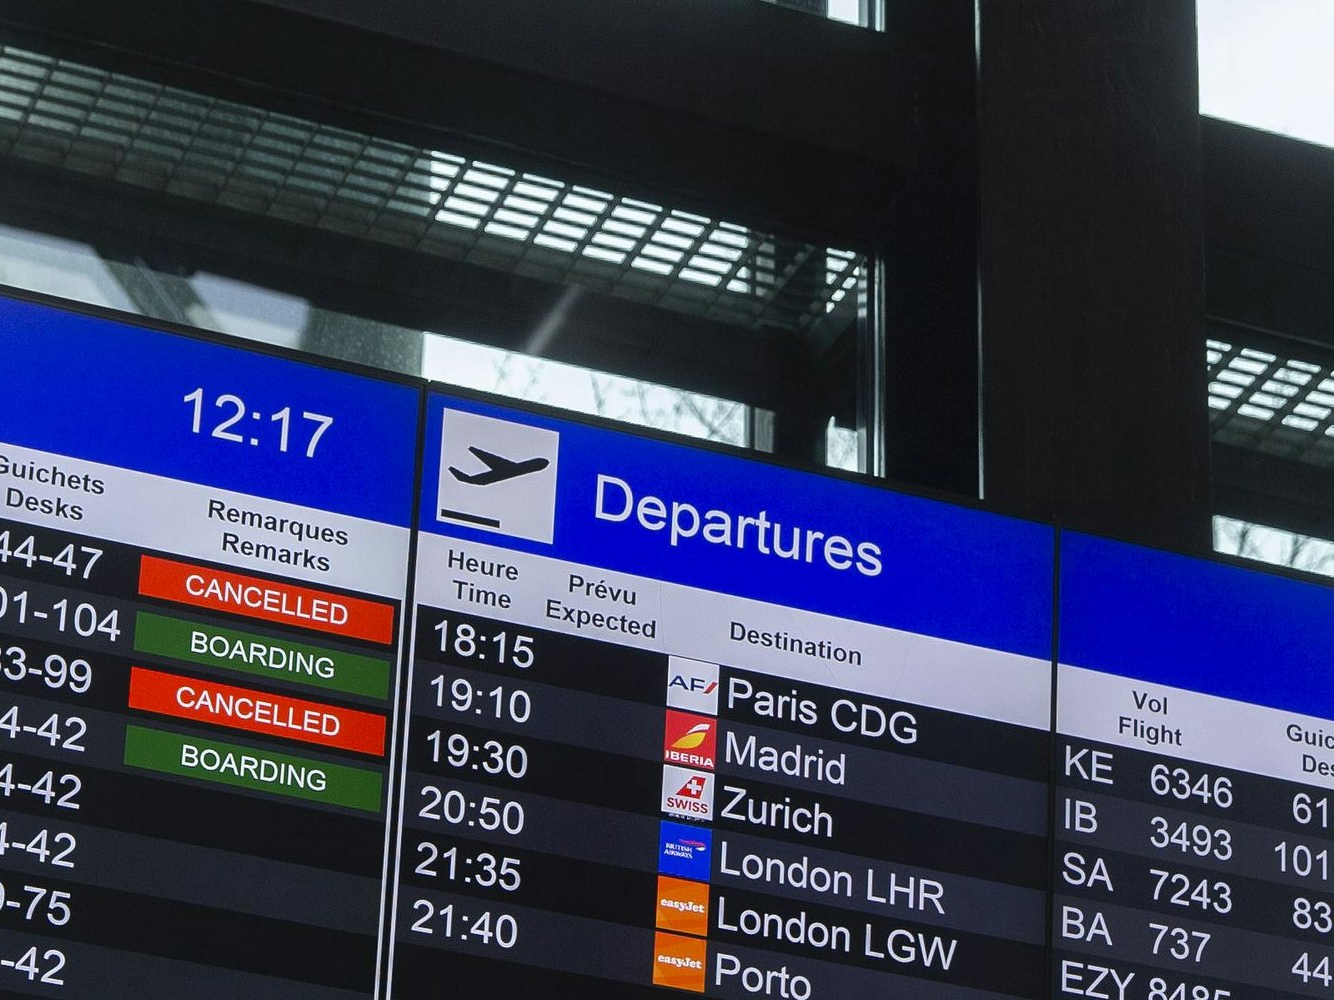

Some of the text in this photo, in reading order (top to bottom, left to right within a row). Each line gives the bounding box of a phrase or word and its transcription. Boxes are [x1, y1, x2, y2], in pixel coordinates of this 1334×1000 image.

[184, 388, 333, 457] 12:17
[6, 488, 82, 520] Desks
[209, 500, 348, 545] Remarques
[596, 474, 882, 576] Departures
[223, 533, 329, 571] Remarks
[449, 550, 518, 580] Heure
[186, 575, 347, 625] CANCELLED
[453, 580, 511, 608] Time
[570, 574, 635, 605] Prévu
[547, 599, 655, 638] Expected
[191, 631, 334, 678] BOARDING
[731, 622, 861, 665] Destination
[177, 687, 339, 736] CANCELLED
[435, 620, 533, 667] 18:15
[729, 678, 817, 724] Paris
[831, 700, 916, 743] CDG
[1066, 745, 1113, 784] KE
[1151, 764, 1232, 807] 6346
[1133, 691, 1167, 714] Vol
[1119, 716, 1182, 746] Flight
[182, 745, 325, 791] BOARDING
[431, 675, 530, 722] 19:10
[726, 731, 845, 785] Madrid
[1066, 799, 1097, 833] IB
[1151, 817, 1232, 860] 3493
[666, 750, 714, 767] IBERIA
[428, 730, 527, 778] 19:30
[721, 786, 832, 837] Zurich
[1063, 852, 1113, 891] SA
[1150, 869, 1232, 913] 7243
[667, 796, 708, 813] SWISS
[419, 786, 524, 834] 20:50
[721, 842, 852, 896] London
[867, 869, 944, 914] LHR
[1063, 906, 1112, 945] BA
[1150, 923, 1210, 962] 737
[415, 842, 520, 891] 21:35
[718, 897, 850, 951] London
[865, 924, 957, 970] LGW
[411, 900, 517, 948] 21:40
[716, 953, 811, 1000] Porto
